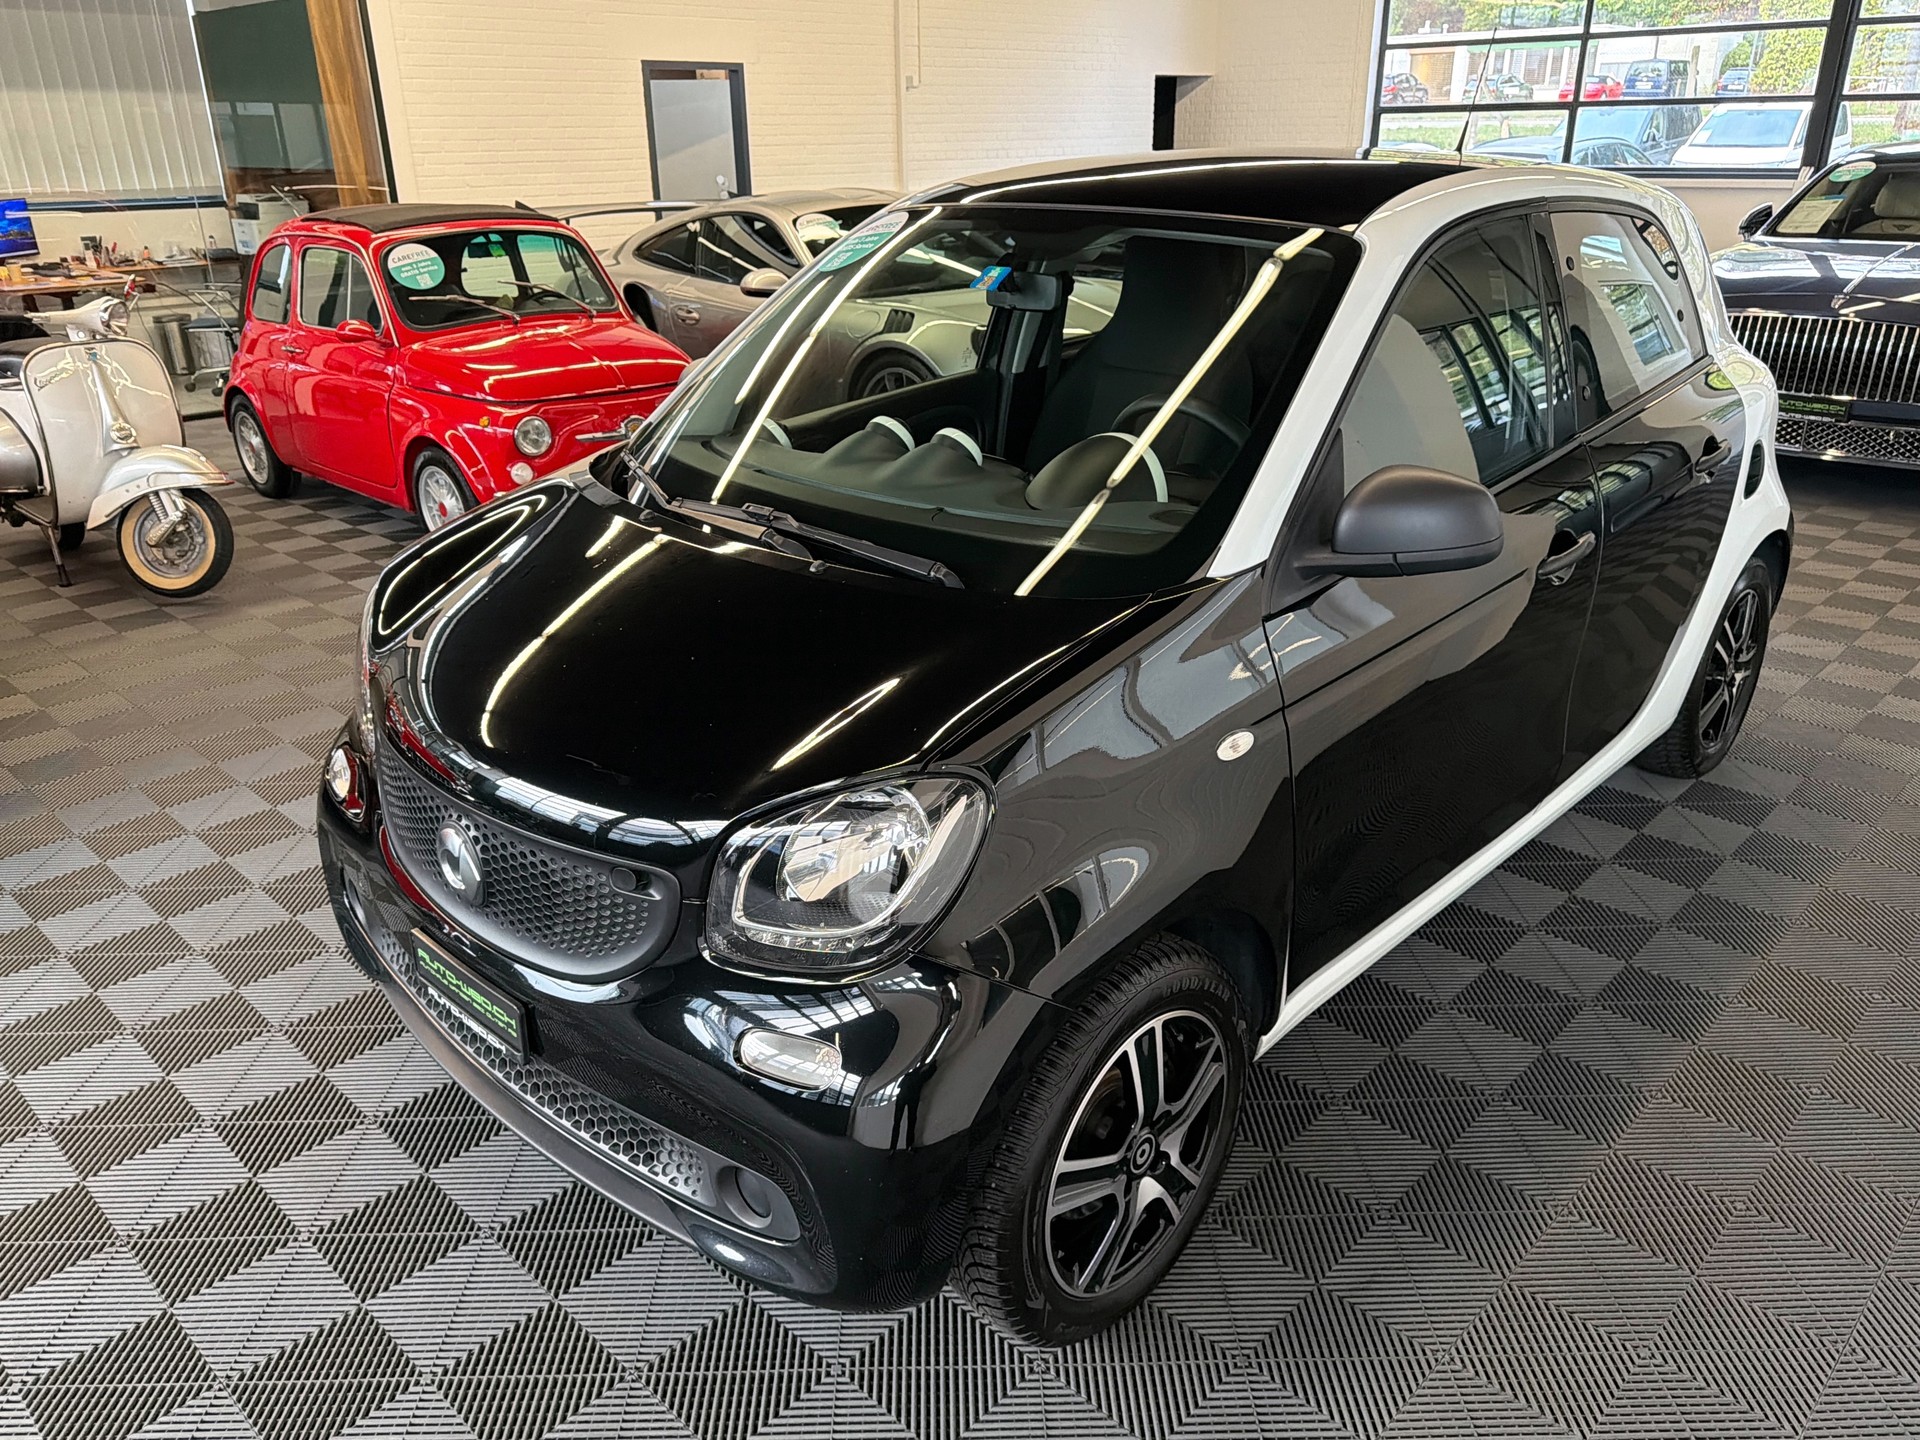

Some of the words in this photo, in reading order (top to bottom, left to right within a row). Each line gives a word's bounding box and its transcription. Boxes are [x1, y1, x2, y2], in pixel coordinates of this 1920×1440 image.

[391, 249, 431, 264] CAREFREE
[400, 269, 420, 278] GRATIS
[419, 264, 438, 273] Service
